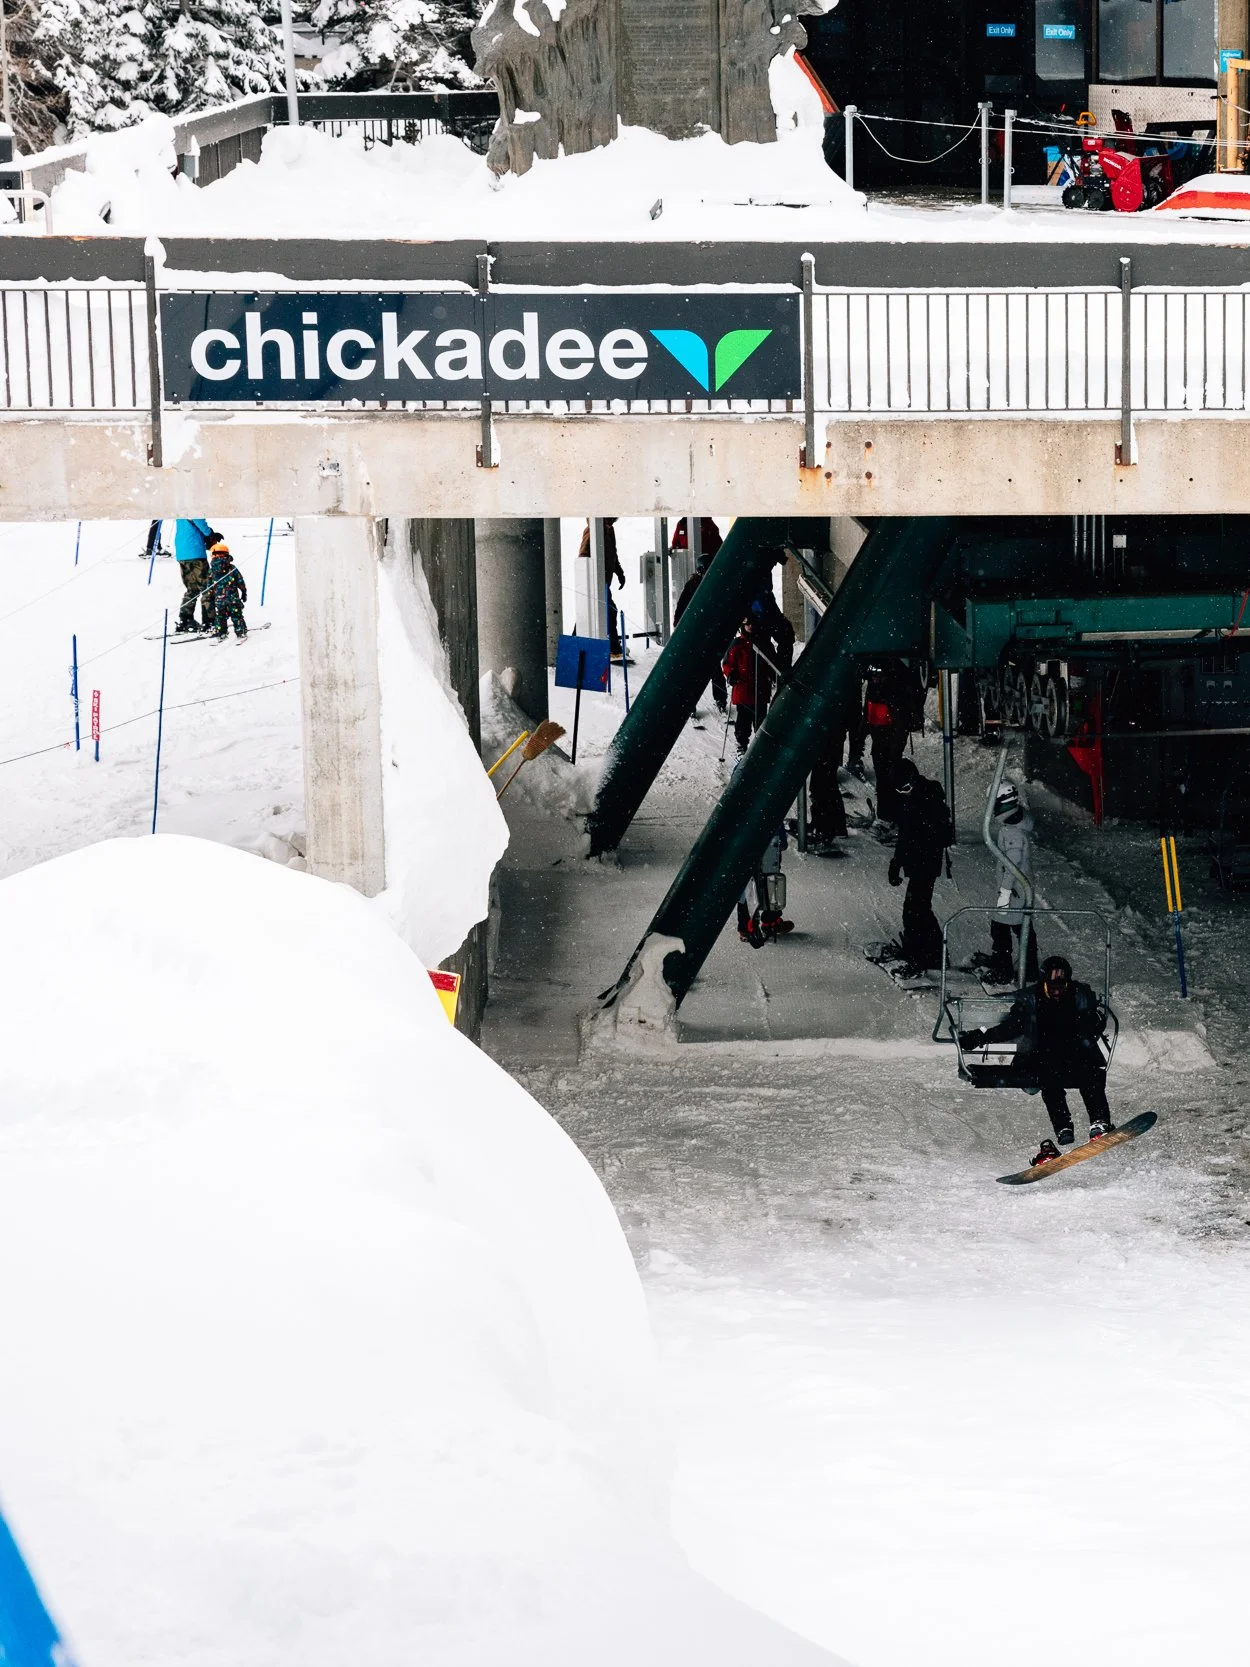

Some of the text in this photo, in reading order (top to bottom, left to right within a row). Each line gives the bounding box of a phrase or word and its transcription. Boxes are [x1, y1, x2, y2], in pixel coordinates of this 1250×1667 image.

[988, 26, 1014, 36] Exit Only
[1045, 27, 1073, 38] Exit Only
[1102, 157, 1122, 170] HONDA
[190, 311, 649, 381] chickadee
